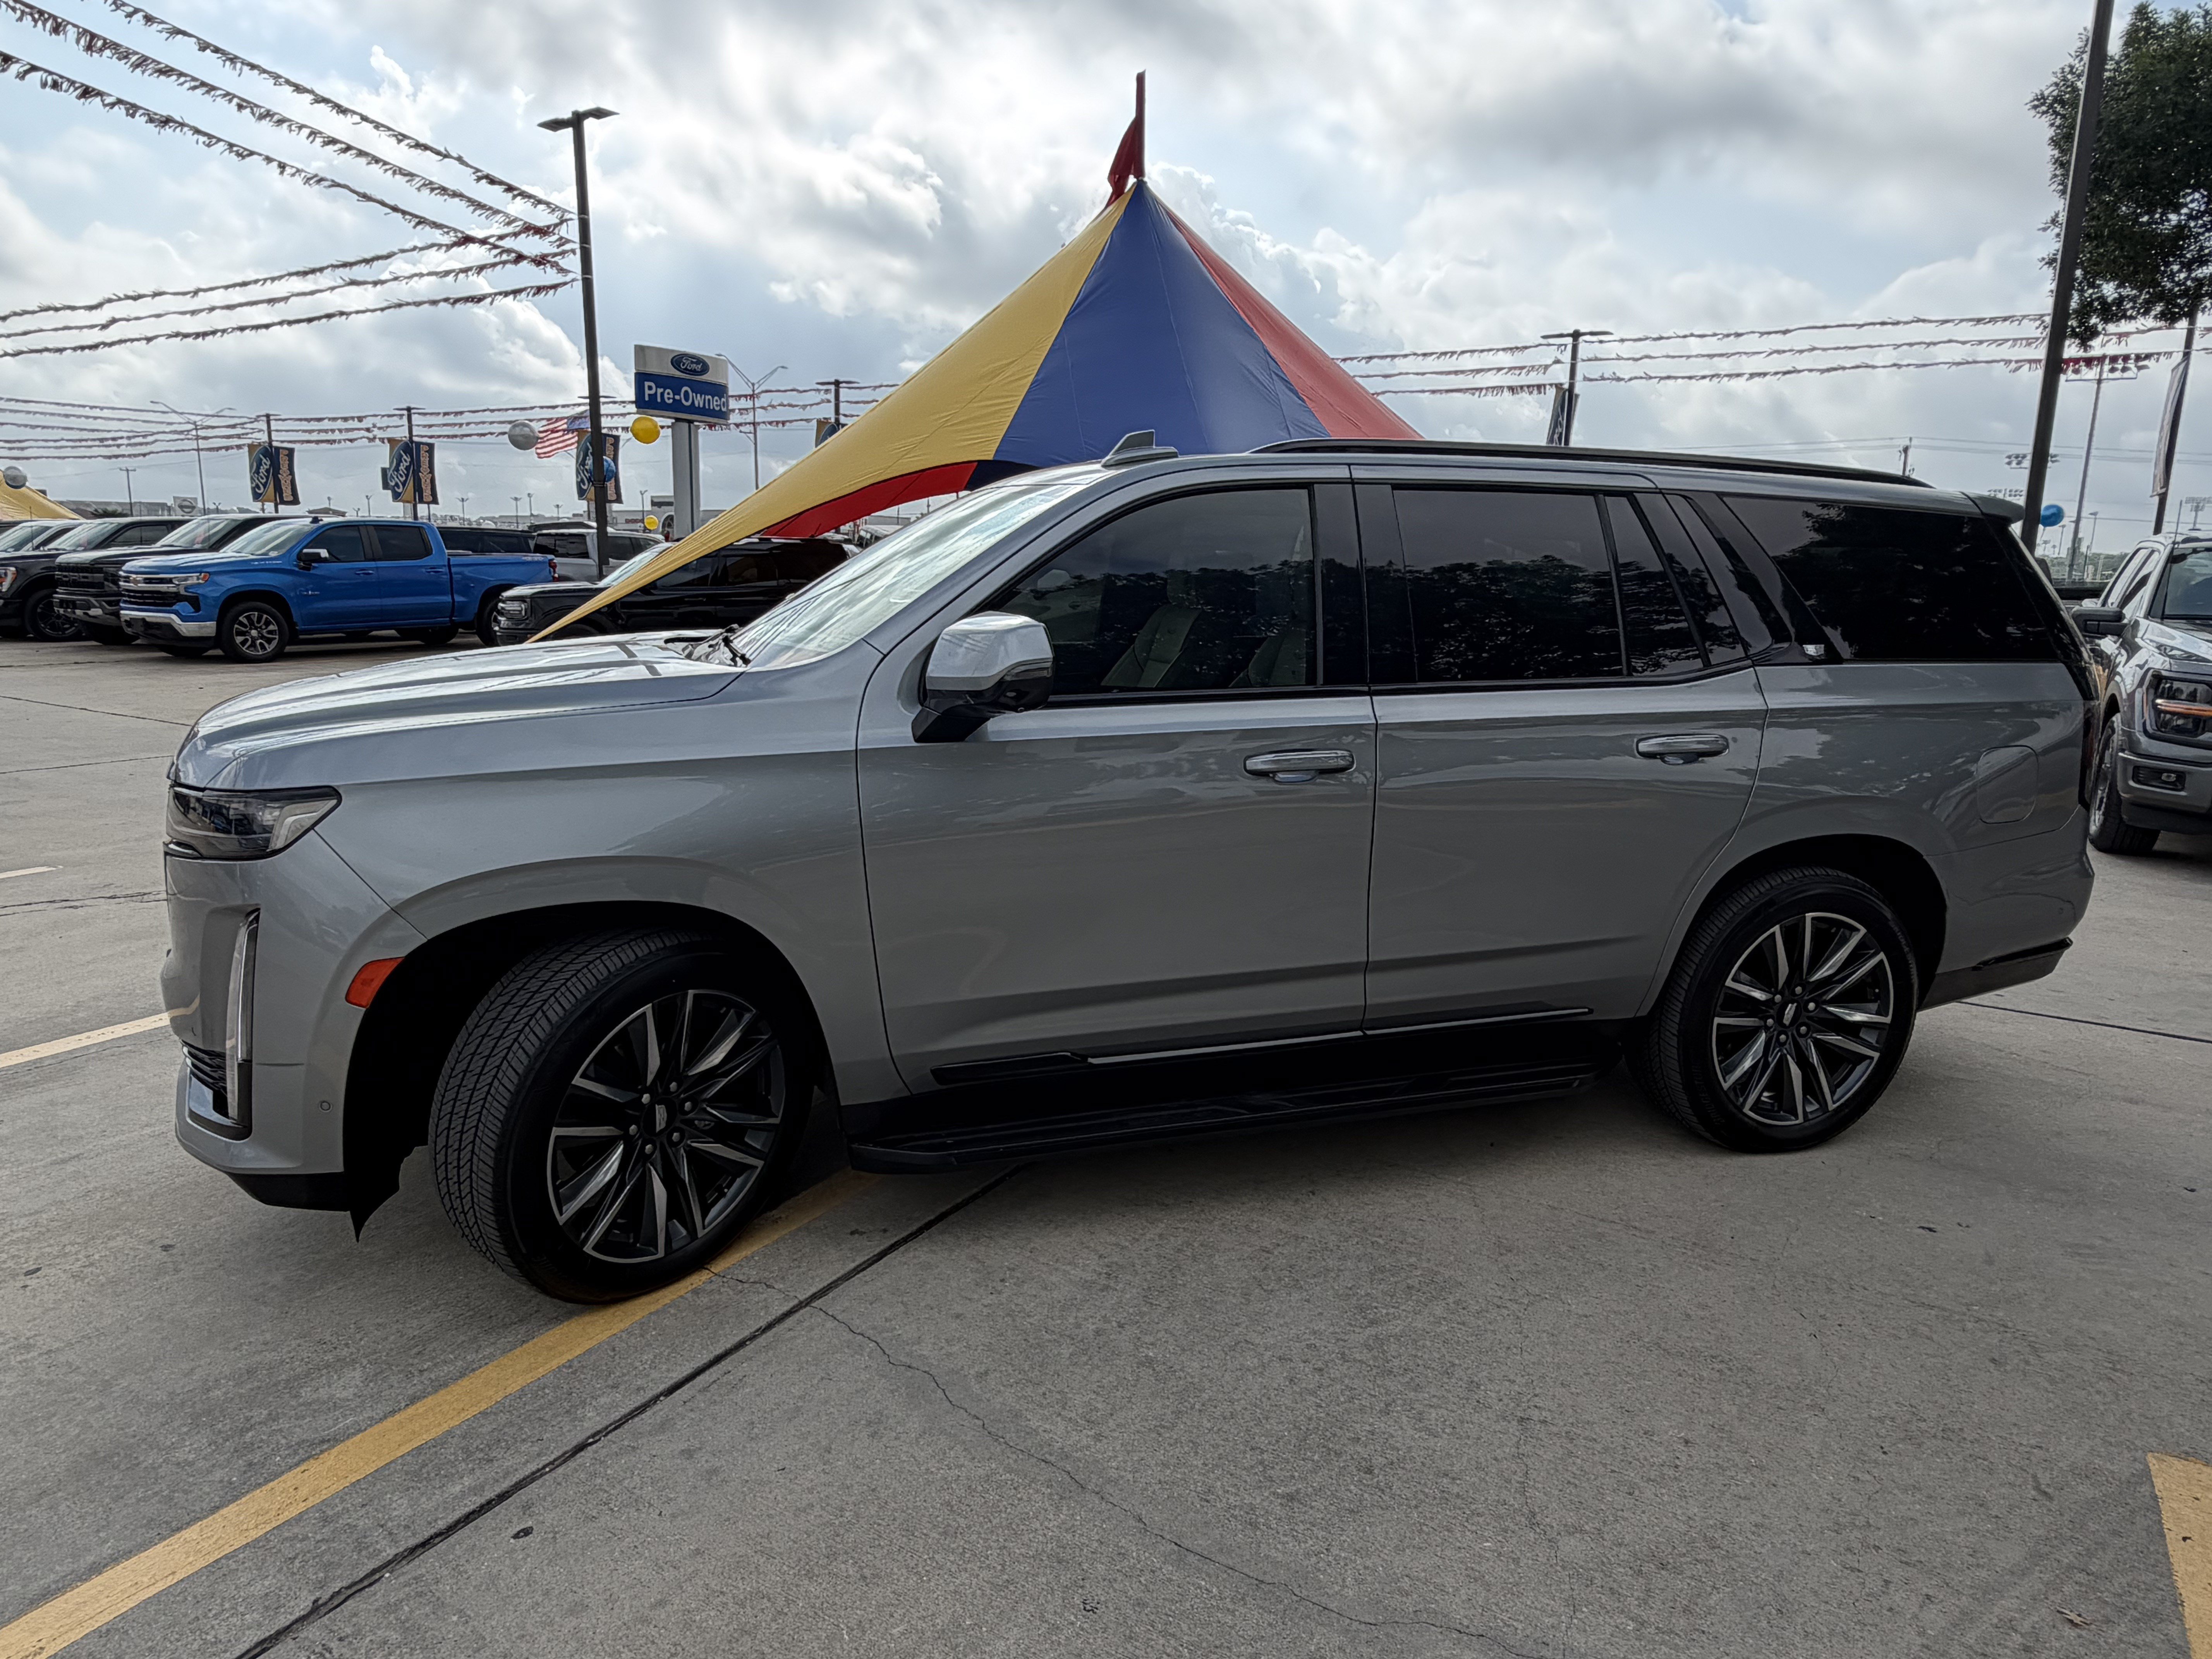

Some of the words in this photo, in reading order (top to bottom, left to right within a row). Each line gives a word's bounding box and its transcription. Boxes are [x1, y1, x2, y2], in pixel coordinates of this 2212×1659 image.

[680, 357, 702, 372] Ford
[644, 381, 727, 412] Pre-Owned
[251, 453, 271, 493] Ford
[388, 449, 411, 493] Ford
